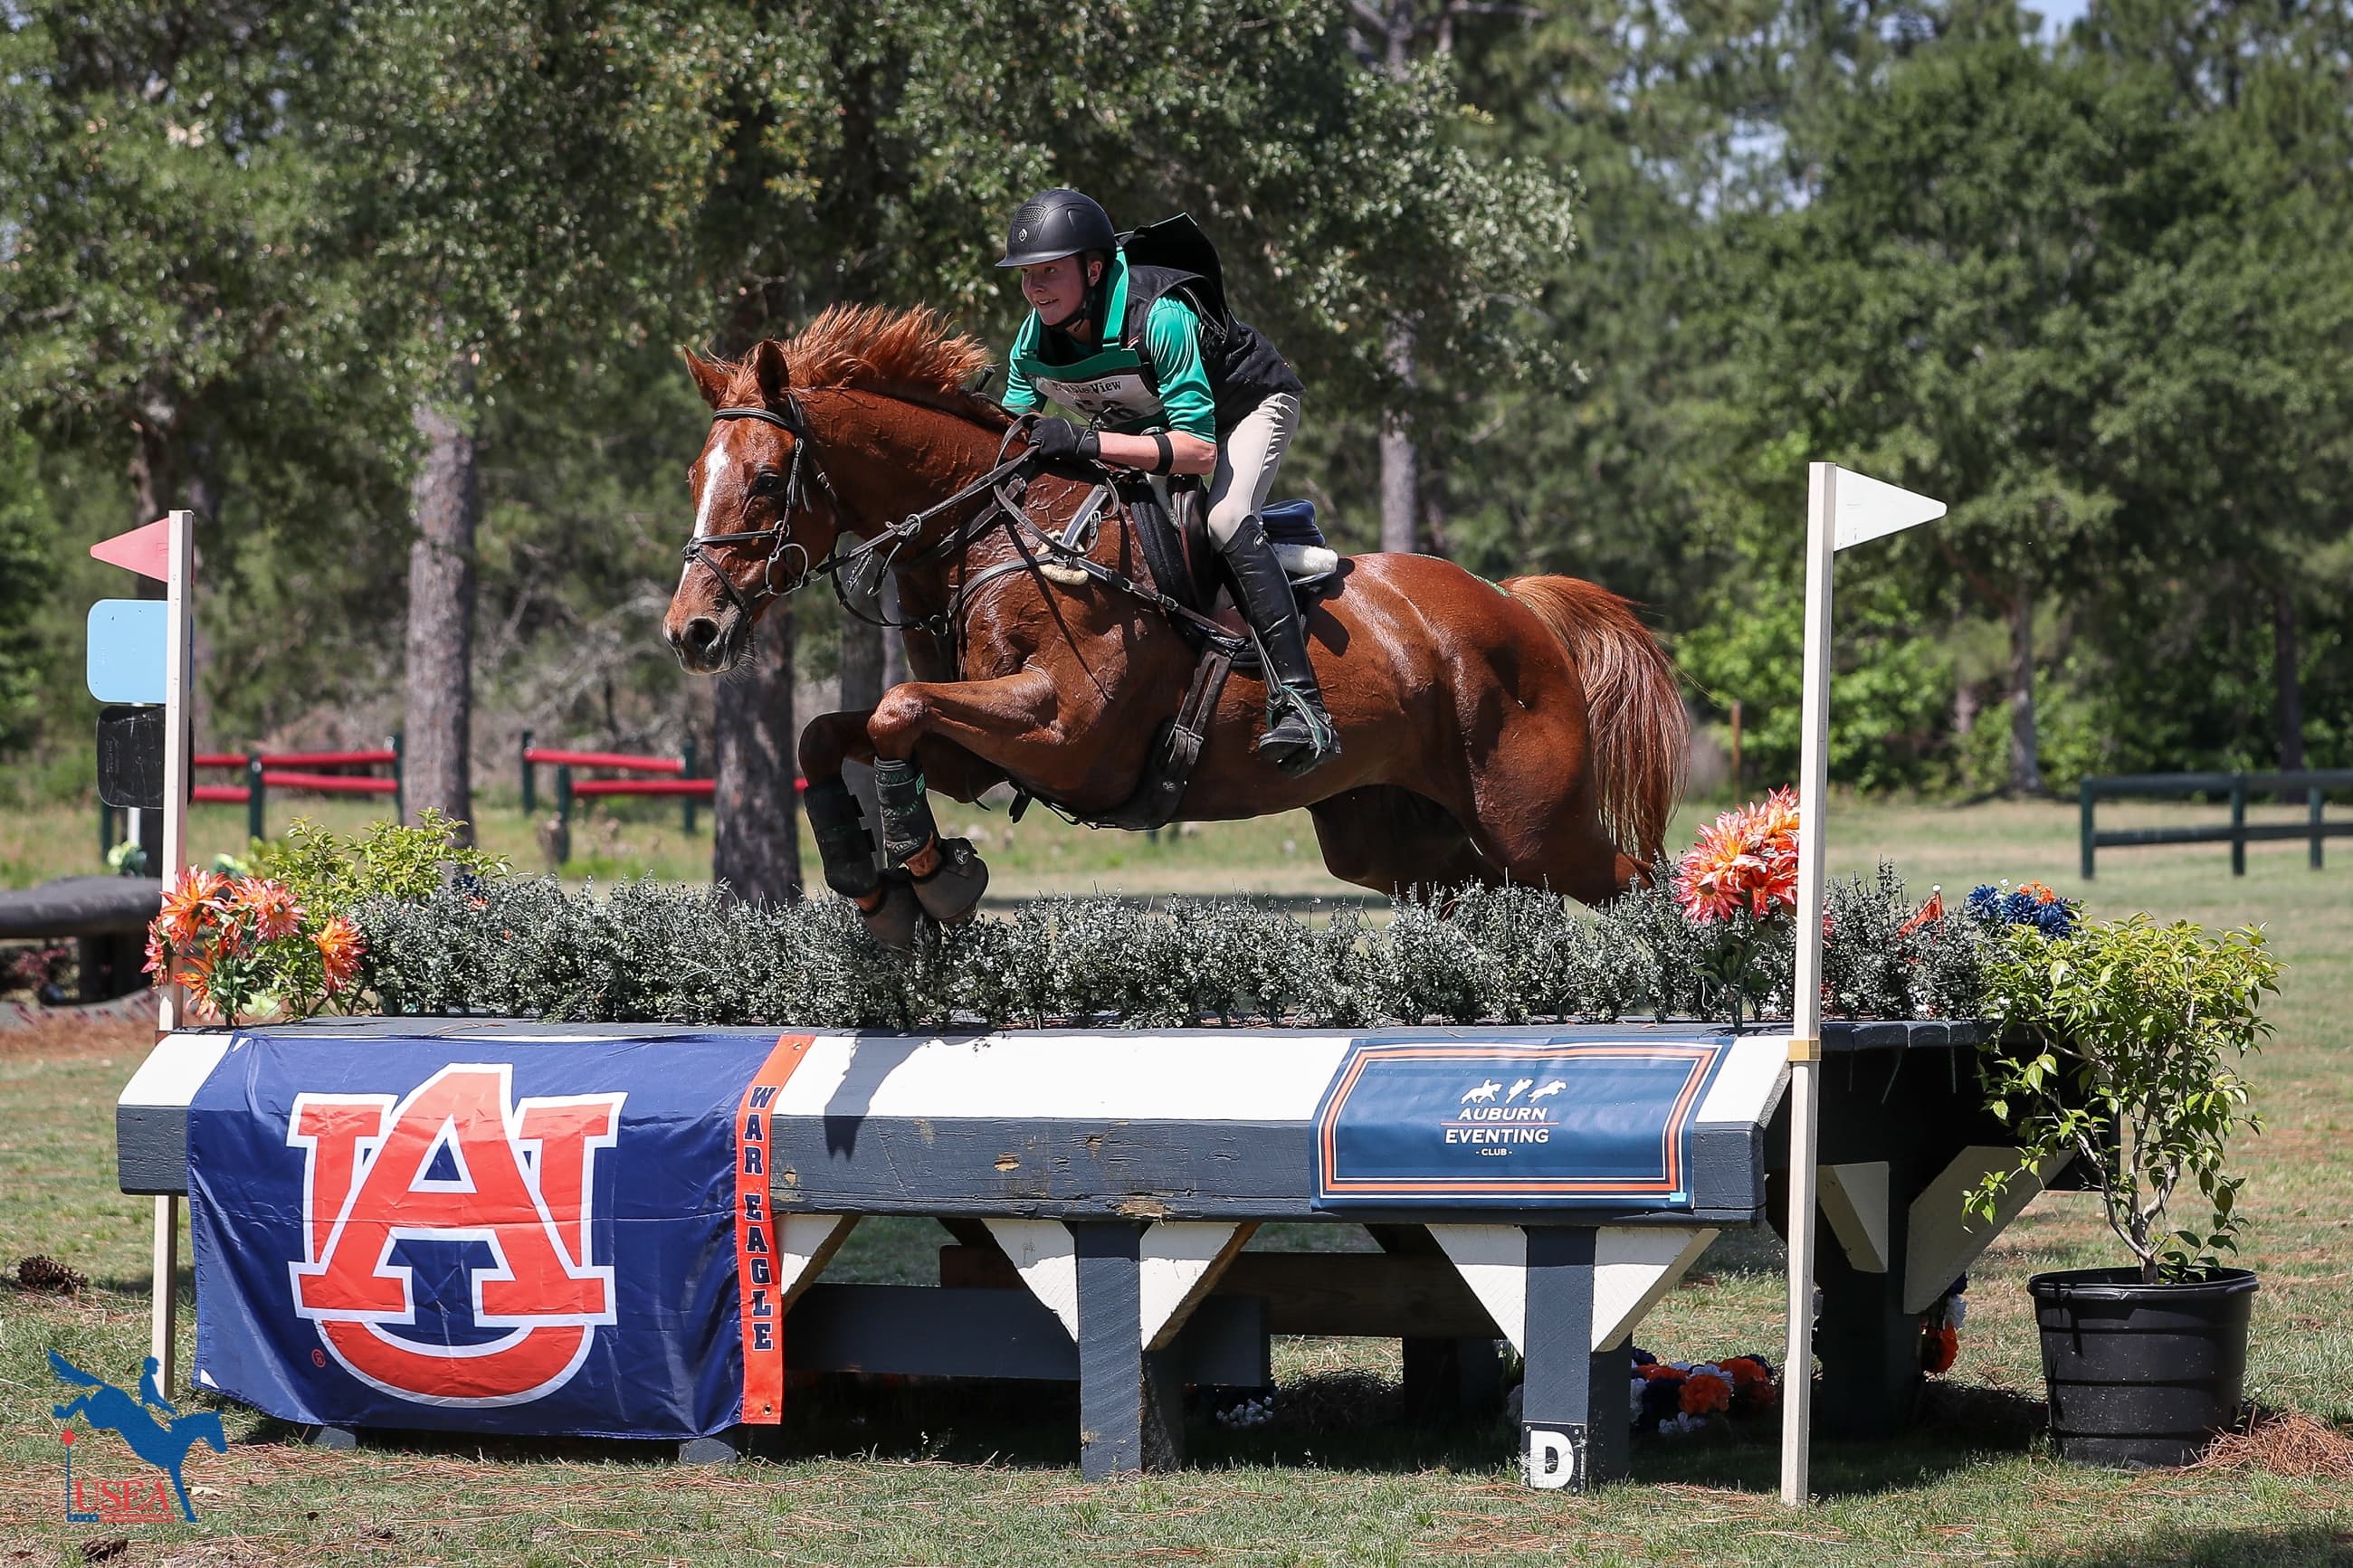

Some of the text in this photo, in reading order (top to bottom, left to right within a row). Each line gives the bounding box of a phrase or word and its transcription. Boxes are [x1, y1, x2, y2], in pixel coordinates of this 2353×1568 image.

[1089, 380, 1121, 394] View
[1457, 1107, 1548, 1122] AUBURN
[1444, 1128, 1549, 1145] EVENTING
[744, 1087, 776, 1351] WAR EAGLE
[1529, 1430, 1575, 1489] D
